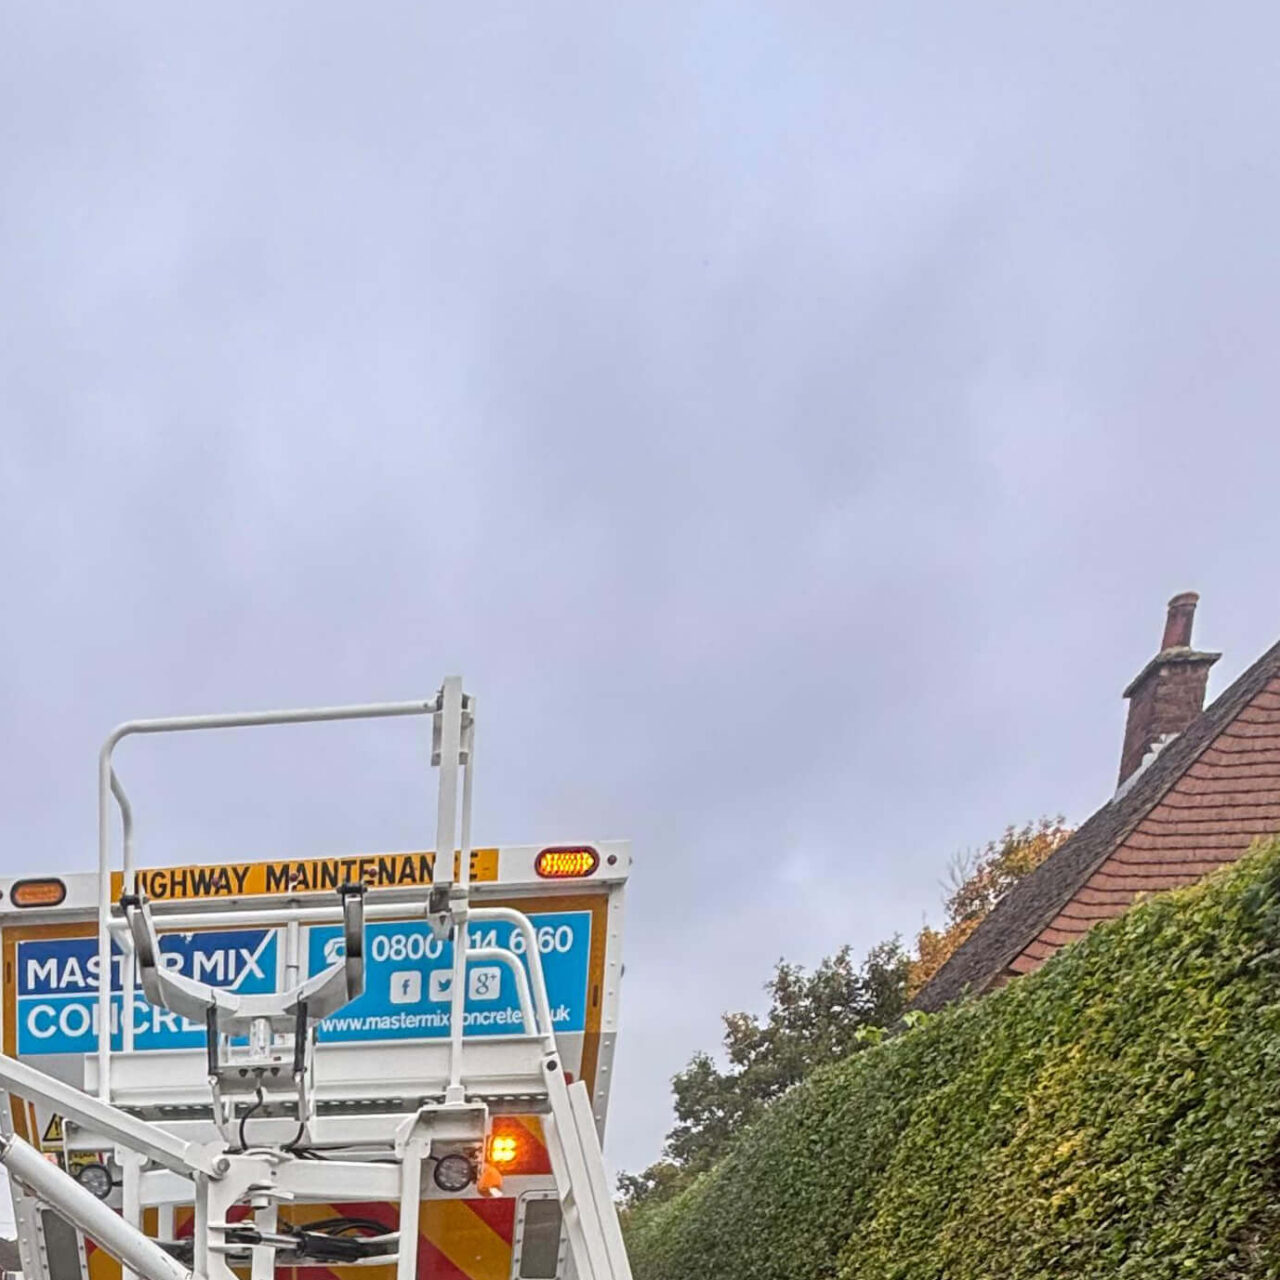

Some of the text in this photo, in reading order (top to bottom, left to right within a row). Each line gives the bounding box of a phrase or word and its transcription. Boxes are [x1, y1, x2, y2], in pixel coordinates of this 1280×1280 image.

[265, 851, 479, 892] MAINTENANE
[371, 924, 574, 962] 0800 14 660
[26, 1000, 209, 1039] CONCR
[321, 1003, 572, 1033] www.mastermixoncreteuk
